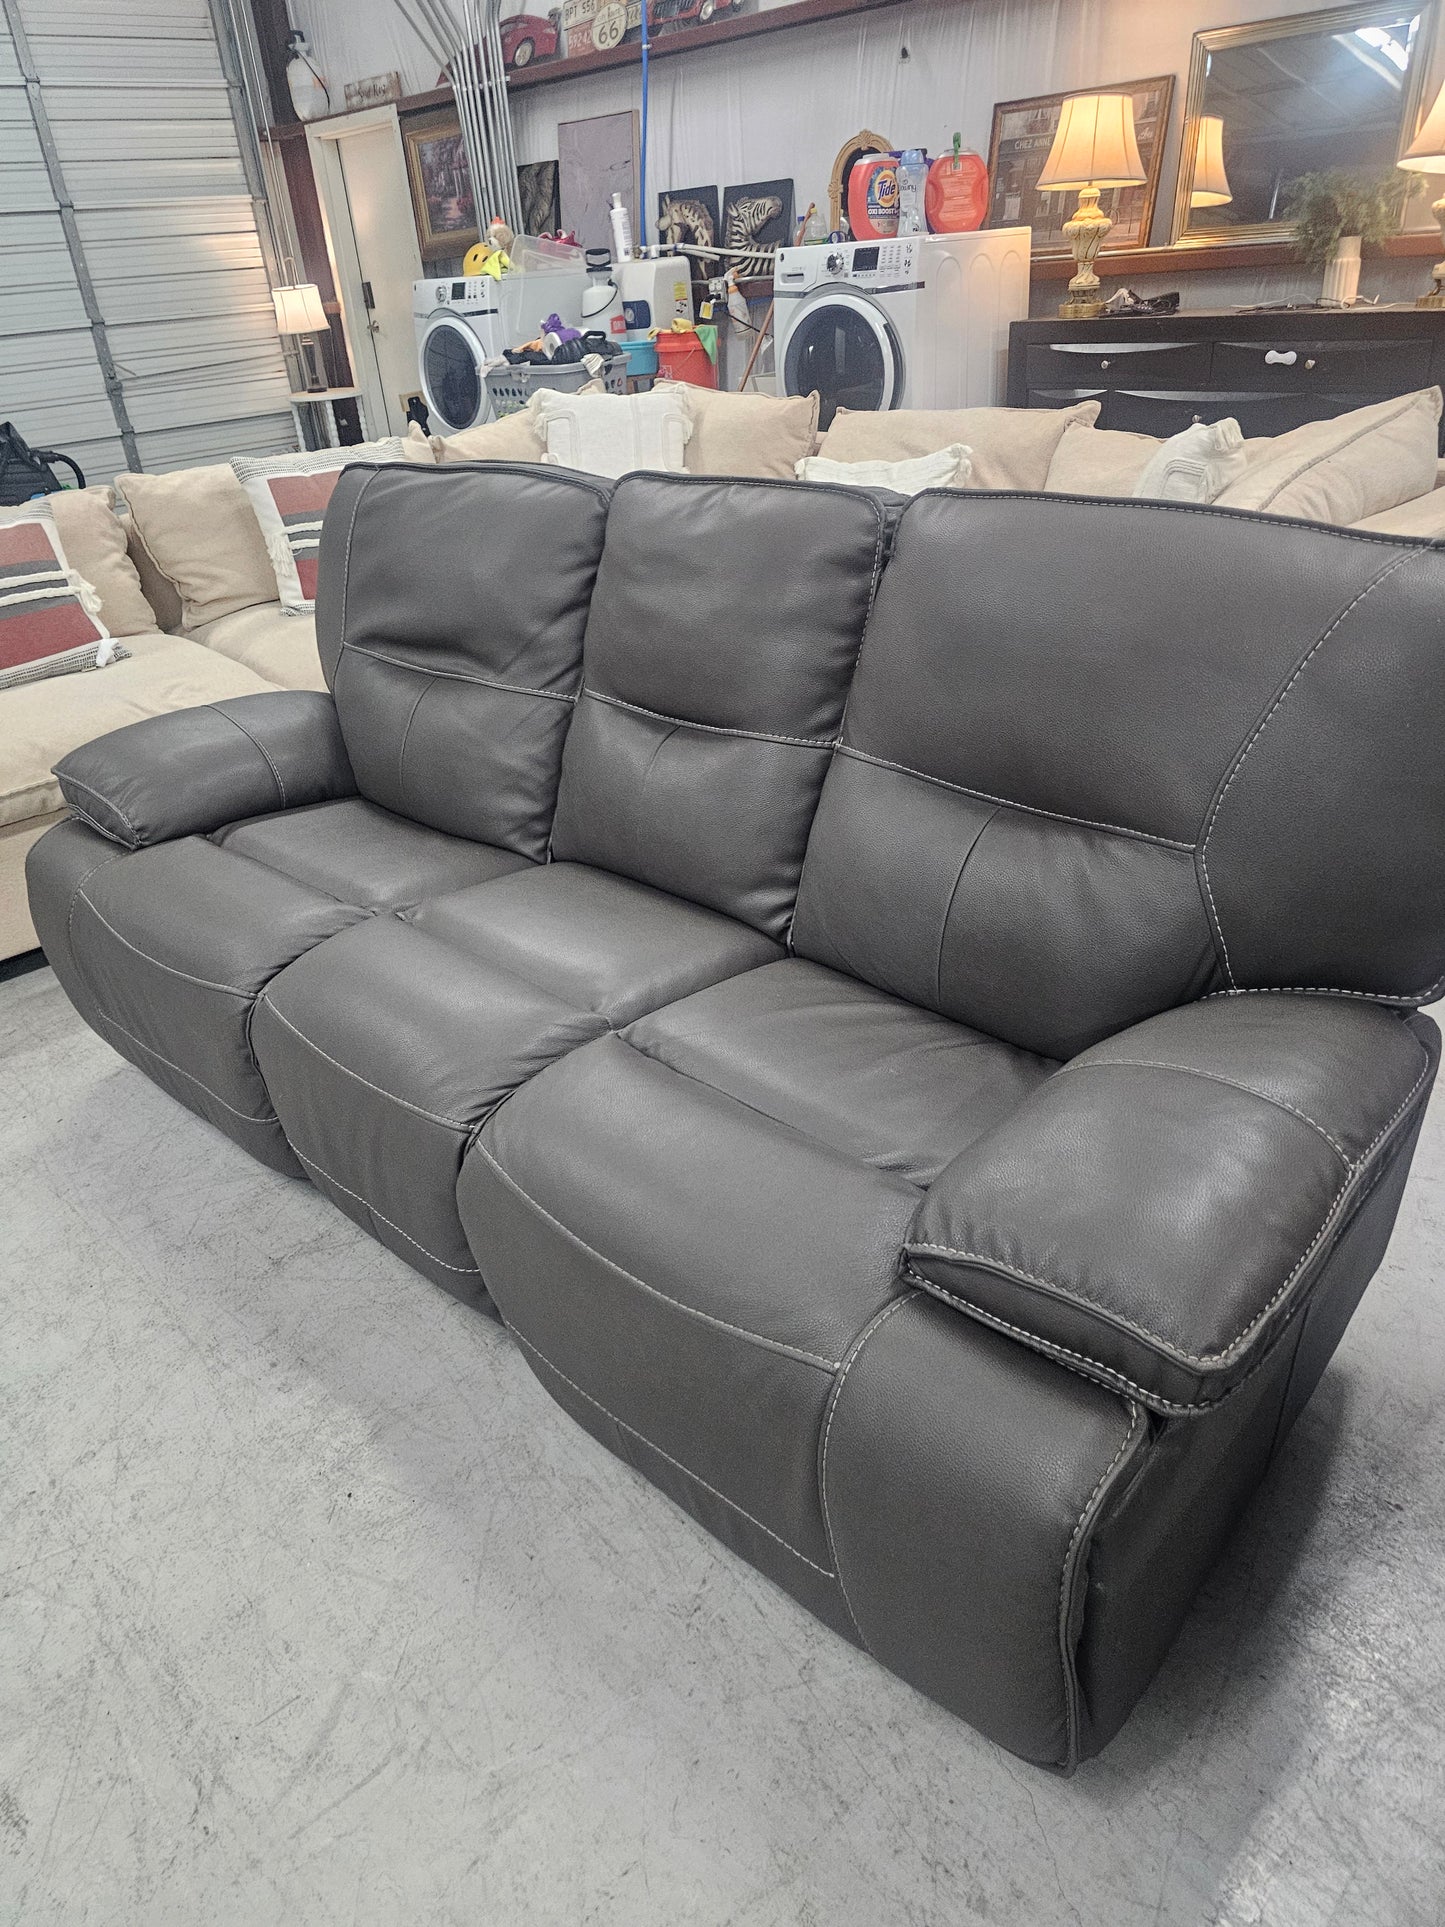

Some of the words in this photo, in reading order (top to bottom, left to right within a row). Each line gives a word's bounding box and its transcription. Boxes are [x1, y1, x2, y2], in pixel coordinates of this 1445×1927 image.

[598, 20, 619, 44] 66
[1014, 138, 1033, 150] CHEZ
[877, 179, 896, 201] Tide
